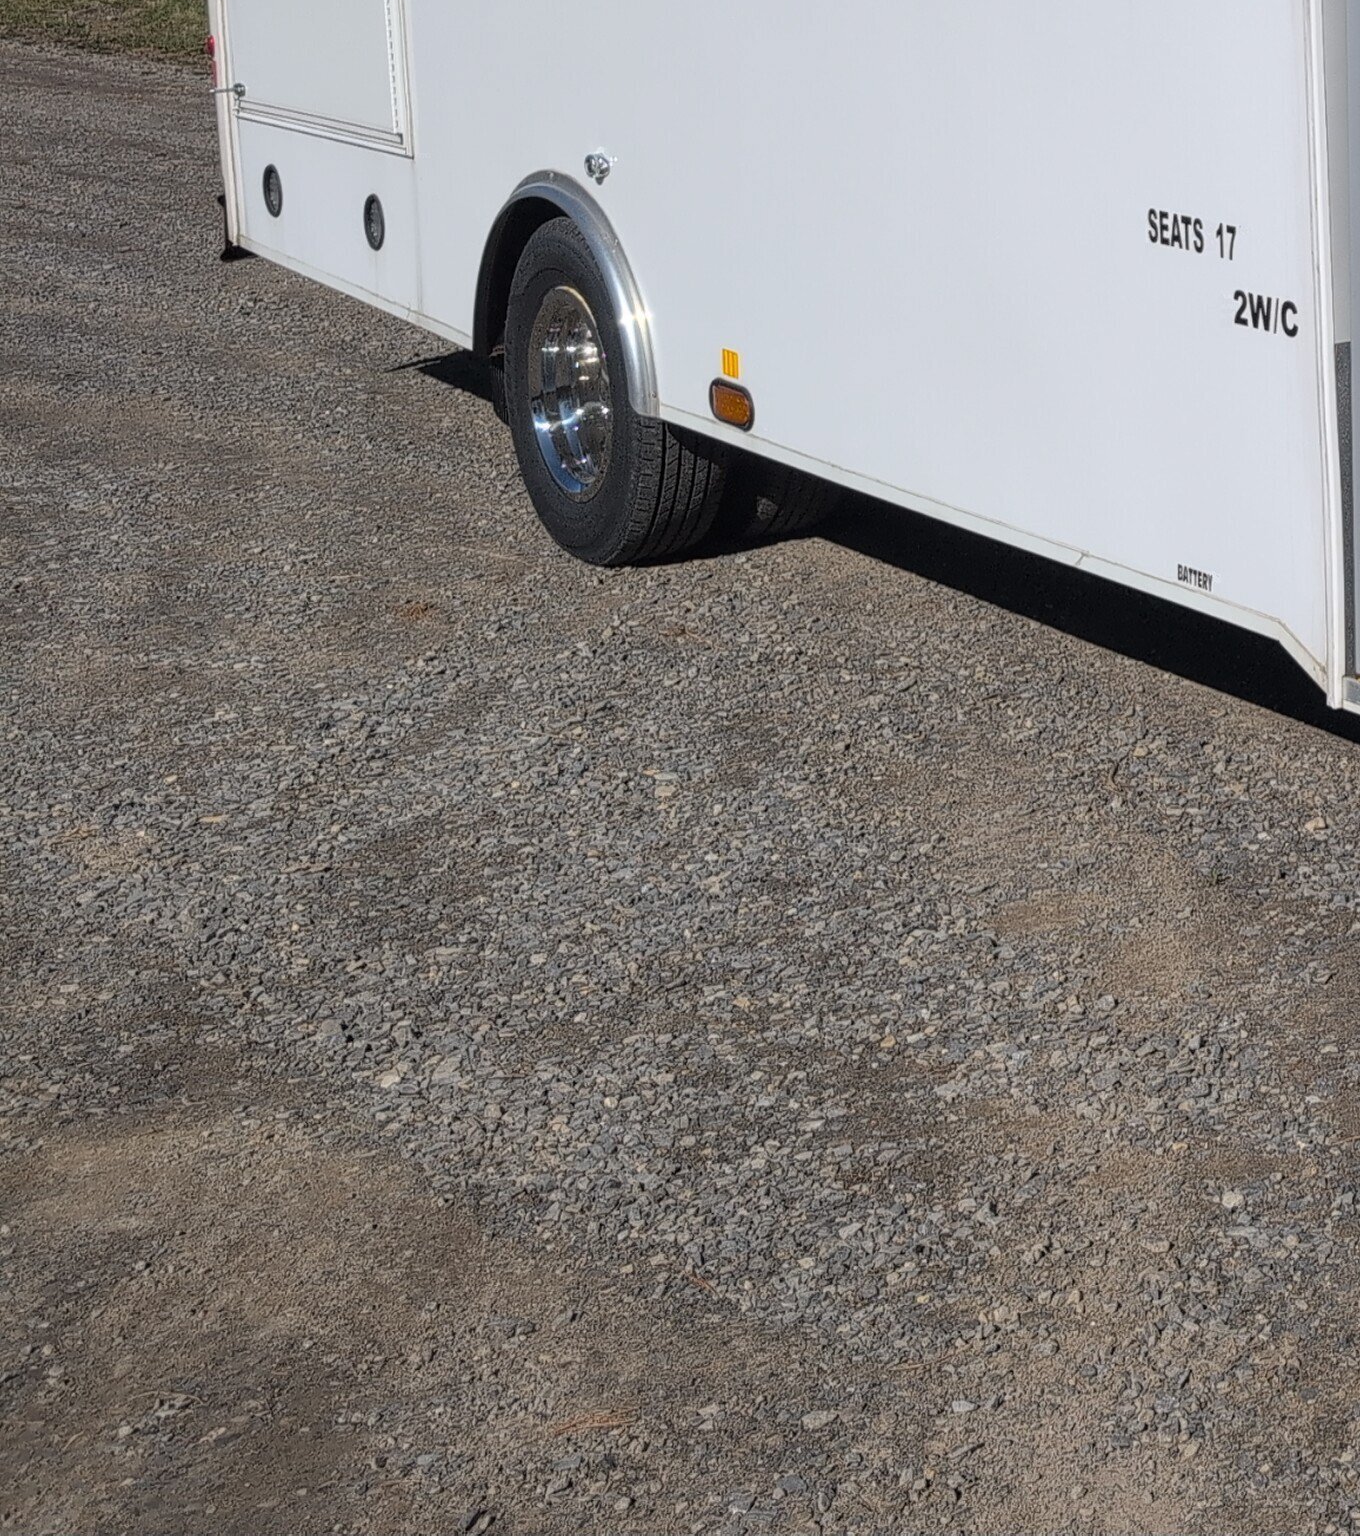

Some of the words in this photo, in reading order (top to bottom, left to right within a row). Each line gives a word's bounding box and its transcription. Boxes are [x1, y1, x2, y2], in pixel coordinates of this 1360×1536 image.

[1147, 208, 1204, 254] SEATS
[1216, 222, 1237, 261] 17
[1233, 289, 1299, 337] 2W/C
[1177, 563, 1213, 592] BATTERY
